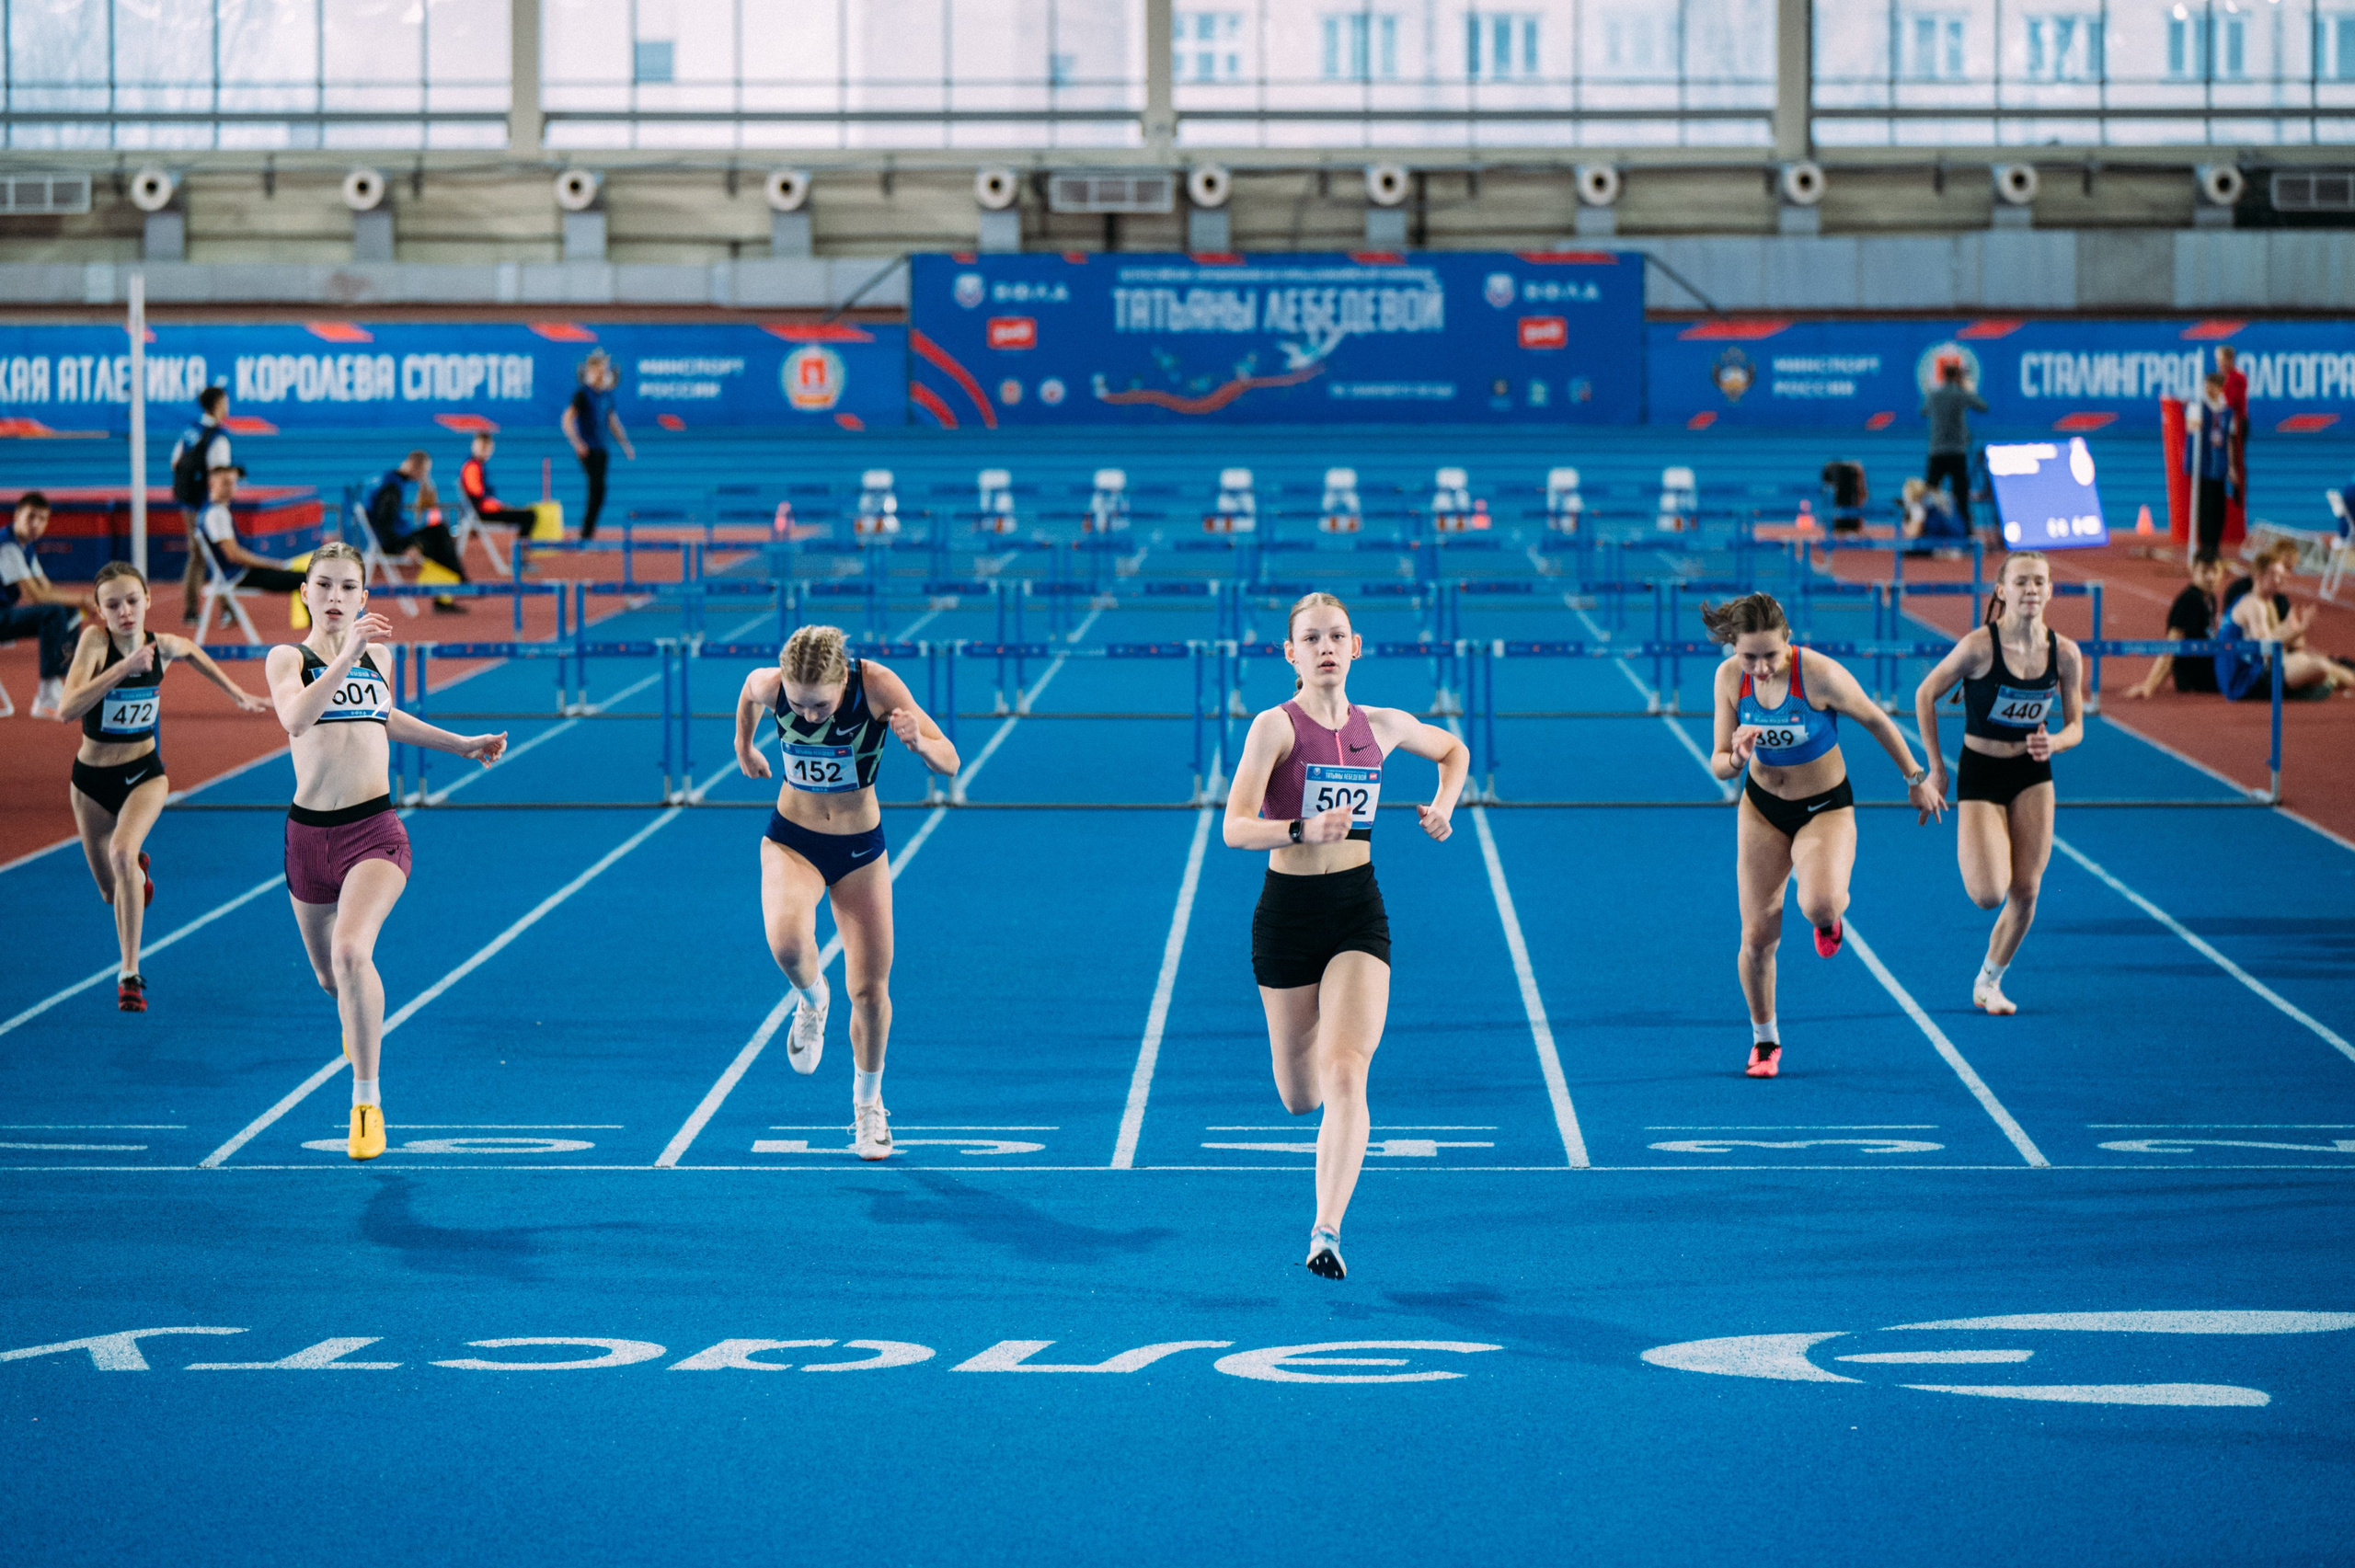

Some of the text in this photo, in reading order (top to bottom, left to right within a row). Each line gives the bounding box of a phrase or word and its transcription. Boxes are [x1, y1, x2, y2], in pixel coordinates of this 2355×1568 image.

[1113, 289, 1257, 331] ТАТЬЯНЫ
[58, 355, 207, 403] АТЛЕИКА
[236, 354, 395, 401] КОРОЛЕВА
[402, 354, 534, 401] СПОРТА!
[2021, 352, 2355, 398] СТАЛИНГРАД ОЛГОГРА
[112, 703, 153, 725] 472
[2001, 702, 2041, 720] 440
[794, 760, 843, 783] 152
[1315, 787, 1369, 815] 502
